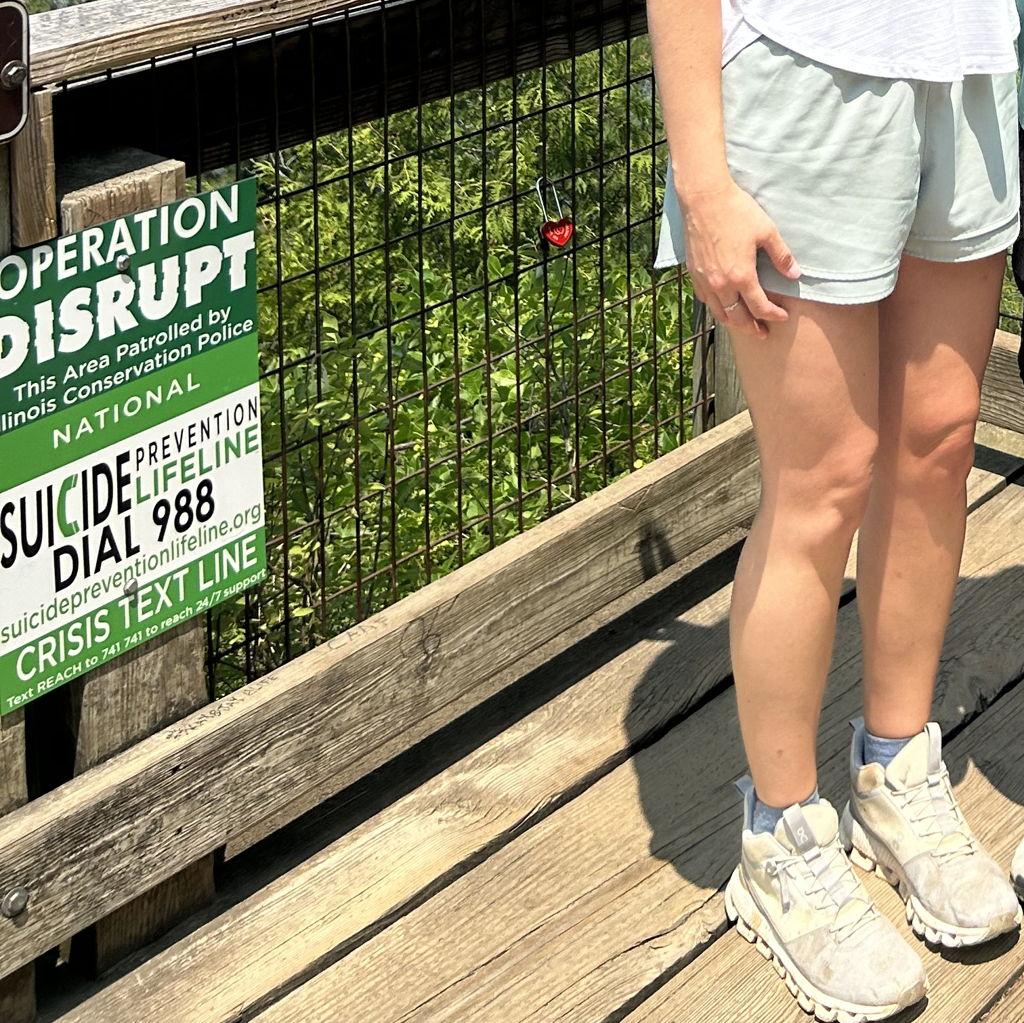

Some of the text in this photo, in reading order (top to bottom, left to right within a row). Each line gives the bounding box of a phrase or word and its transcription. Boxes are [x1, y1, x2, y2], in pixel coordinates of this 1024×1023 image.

[0, 185, 239, 300] OPERATION
[0, 231, 255, 378] DISRUPT
[13, 307, 232, 402] This Area Patrolled by
[1, 319, 254, 432] linois Conservation Police
[53, 372, 201, 449] NATIONAL
[136, 396, 258, 471] PREVENTION
[136, 424, 260, 505] LIFELINE
[0, 450, 132, 569] SUICIDE
[53, 478, 215, 593] DIAL 988
[1, 503, 262, 644] suicidepreventionlifeline.org
[16, 534, 258, 681] CRISIS TEXT LINE
[6, 568, 267, 708] Text REACH to 741 741 to reach 24/7 support
